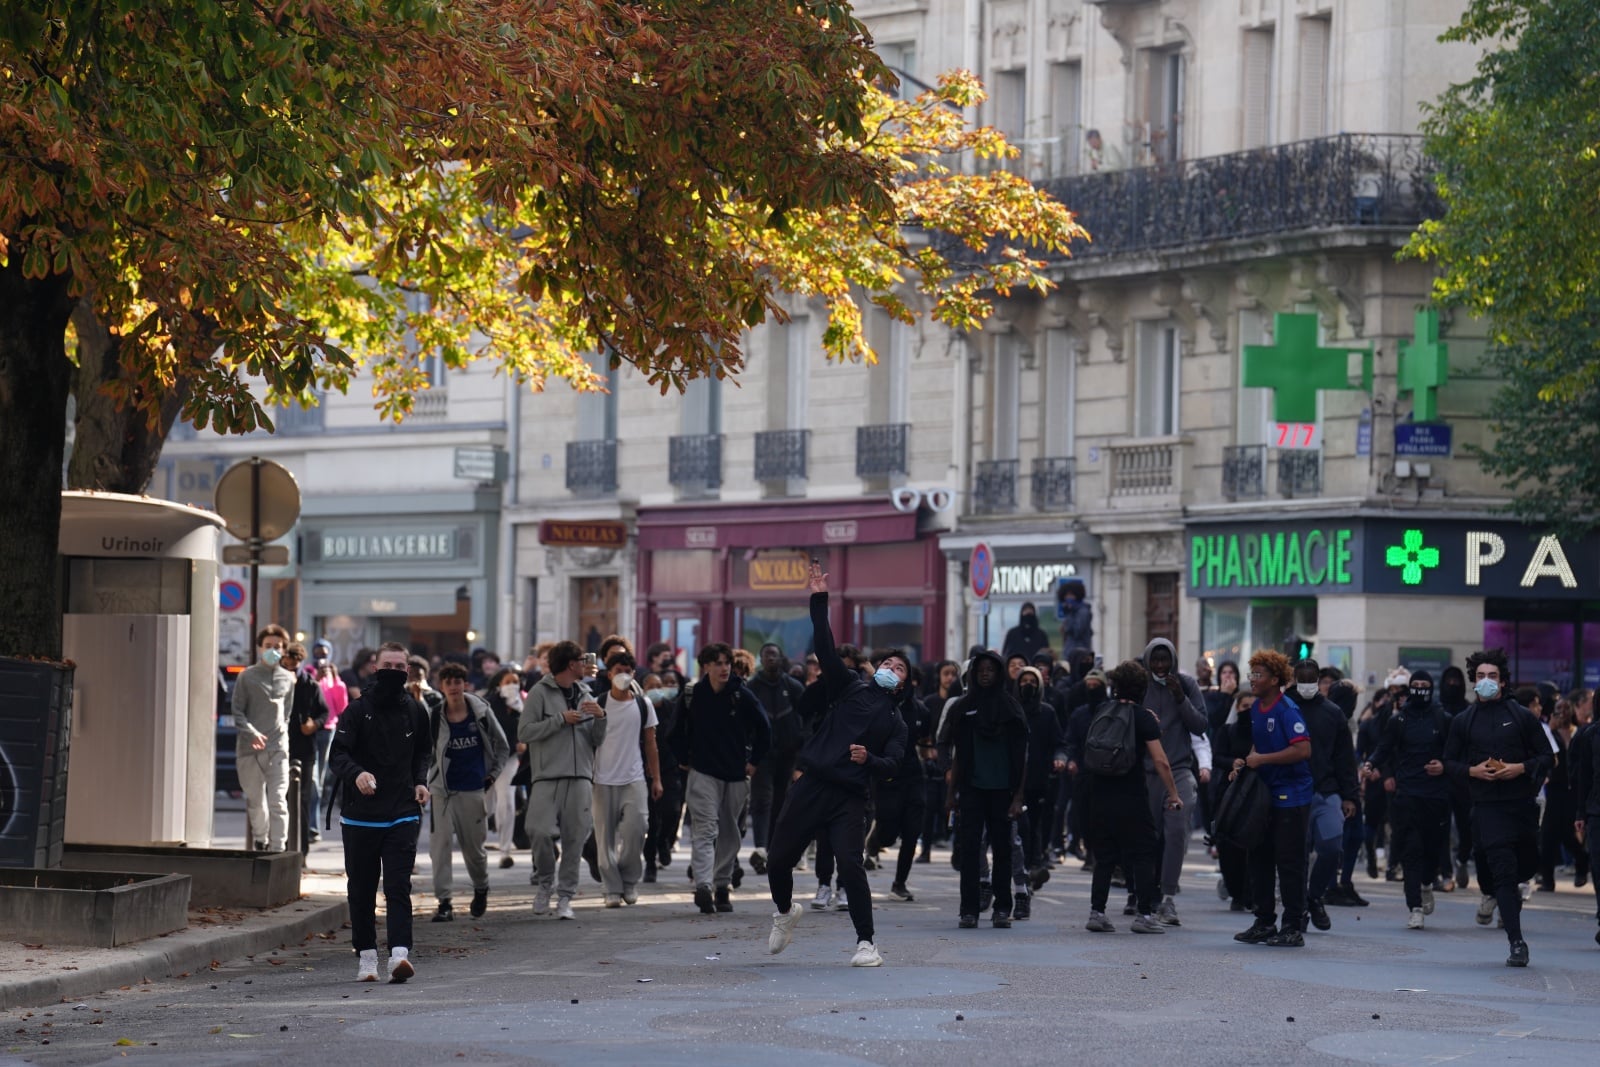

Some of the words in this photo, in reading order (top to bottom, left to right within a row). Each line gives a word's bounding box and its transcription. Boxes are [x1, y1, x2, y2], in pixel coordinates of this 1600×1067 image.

[1276, 422, 1315, 448] 7/7
[102, 536, 163, 552] Urinoir
[323, 534, 449, 557] BOULANGERIE
[551, 526, 619, 542] NICOLAS
[753, 558, 807, 583] NICOLAS
[1191, 529, 1351, 588] PHARMACIE
